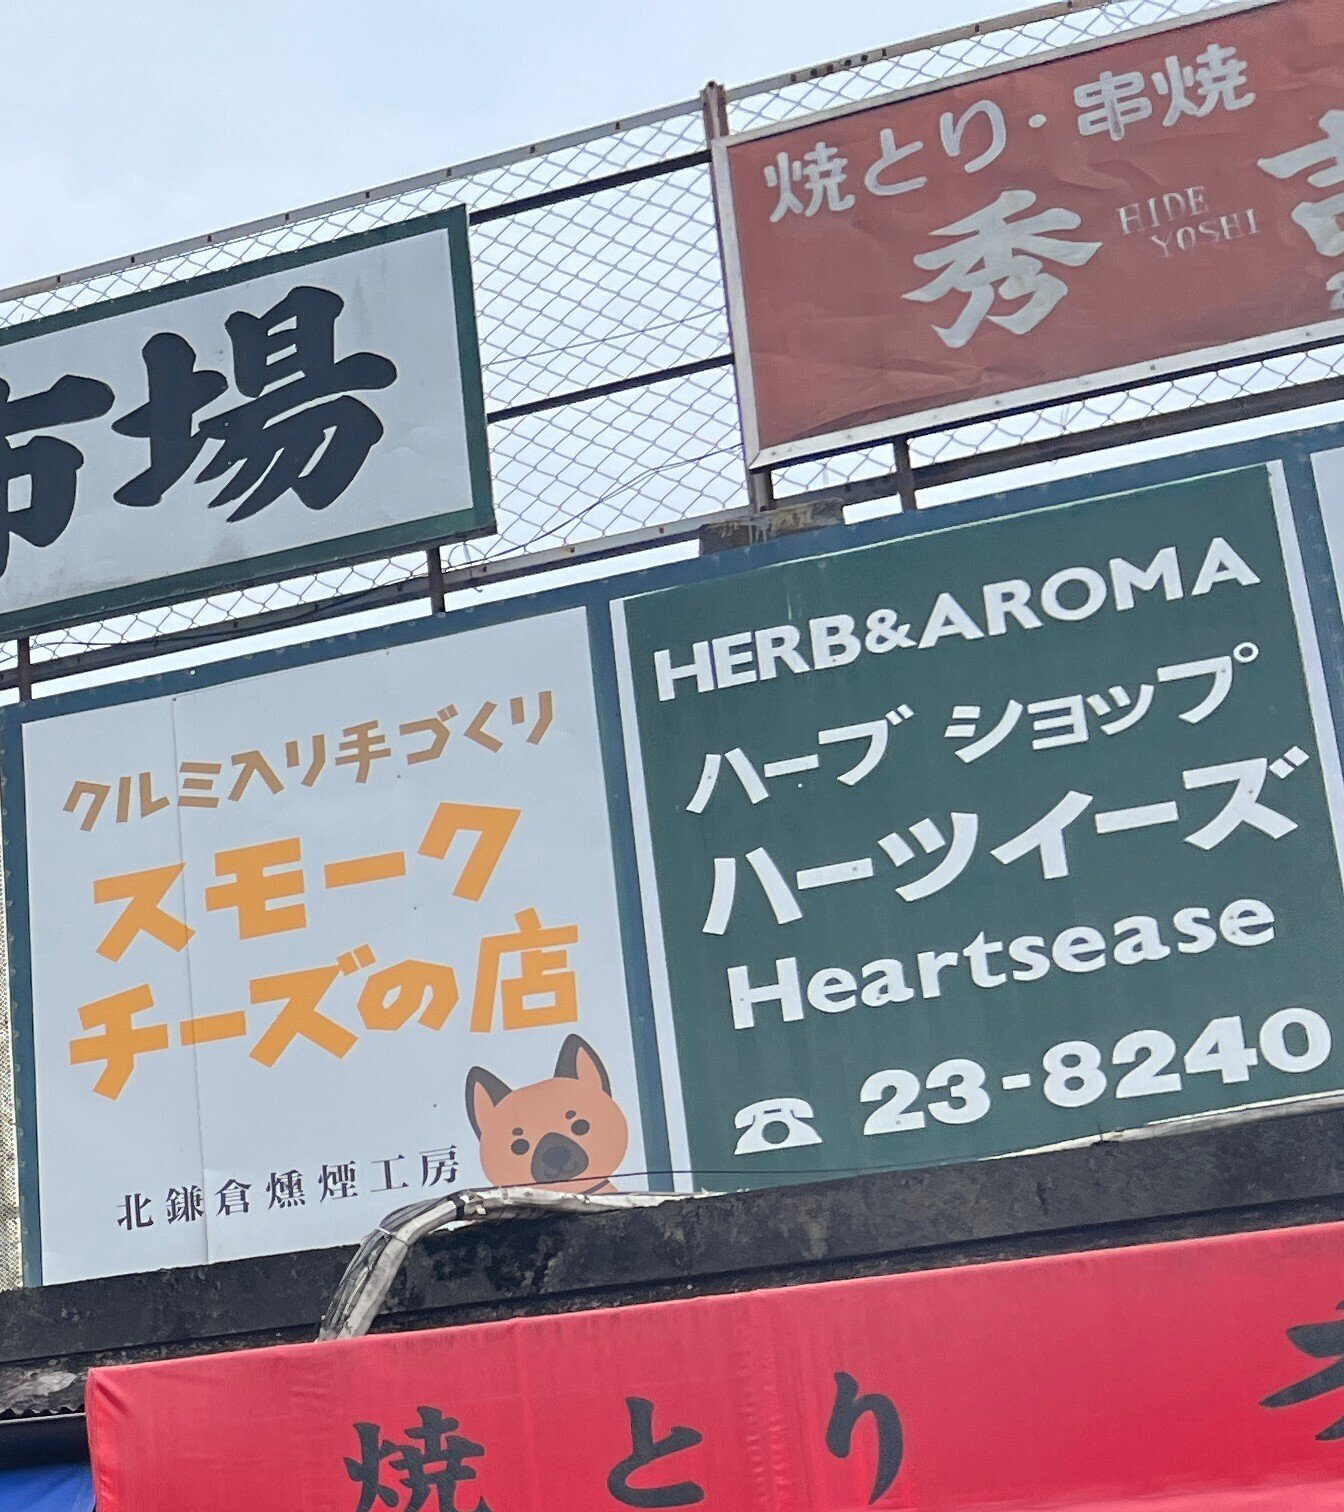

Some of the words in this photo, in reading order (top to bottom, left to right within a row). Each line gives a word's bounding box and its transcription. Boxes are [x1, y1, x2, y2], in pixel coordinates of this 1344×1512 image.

[902, 188, 1103, 349] 秀
[1119, 184, 1208, 237] HIDE
[1149, 207, 1261, 260] YOSHI
[653, 536, 1261, 702] HERB&AROMA
[62, 690, 555, 832] クルミ入り手づくり
[686, 703, 915, 814] ハーブ
[944, 642, 1260, 764] ショップ
[92, 800, 522, 964] スモーク
[702, 746, 1310, 936] ハーツイーズ
[68, 906, 580, 1101] チーズの店
[727, 898, 1276, 1031] Heartsease
[859, 1007, 1332, 1137] 23-8240
